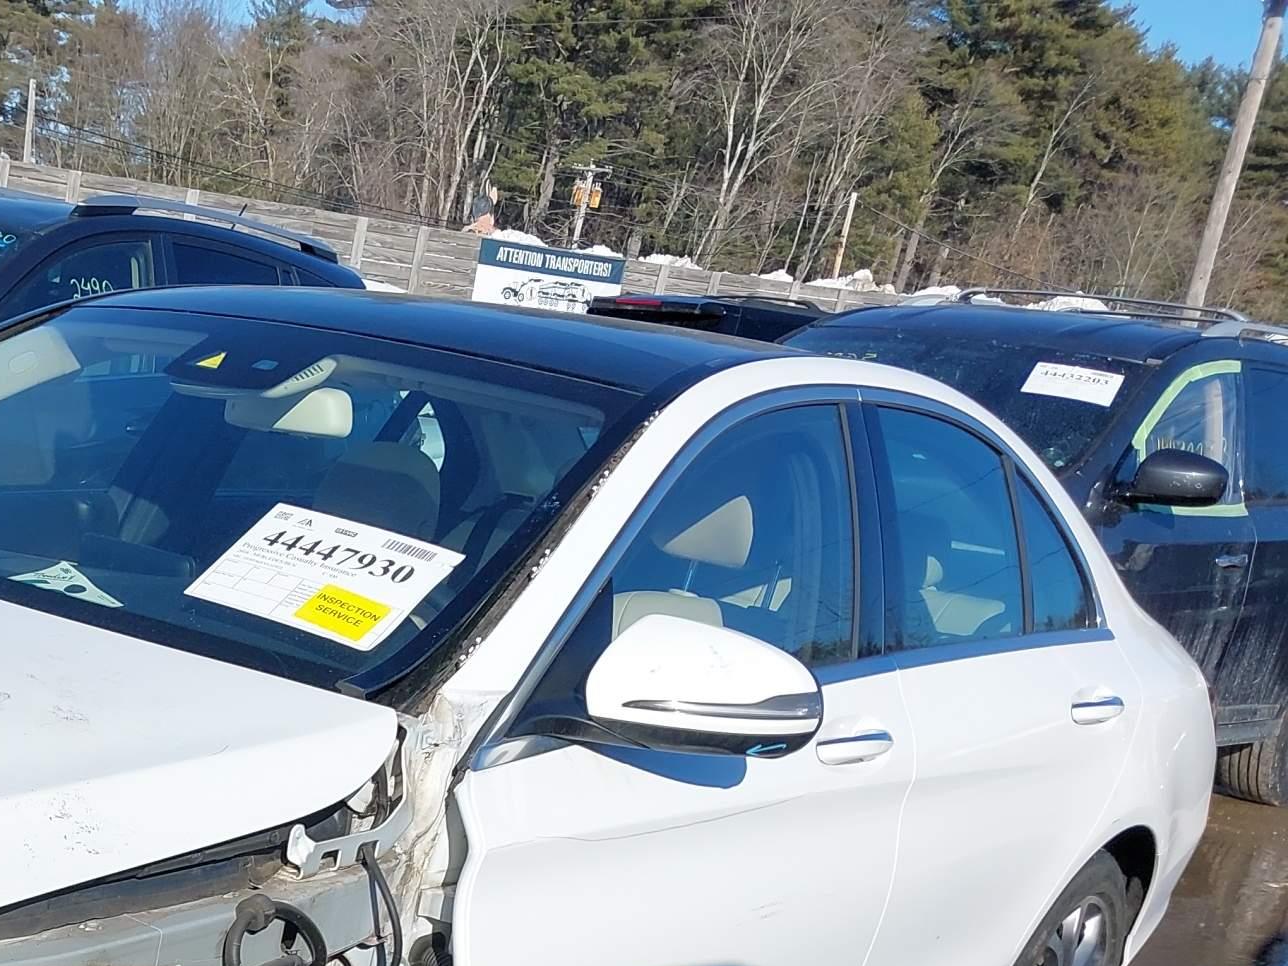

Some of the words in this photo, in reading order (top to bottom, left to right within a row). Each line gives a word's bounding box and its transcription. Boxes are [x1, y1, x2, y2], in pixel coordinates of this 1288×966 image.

[496, 246, 544, 268] ATTENTION
[544, 254, 613, 278] TRANSPORTERS!
[263, 529, 415, 584] 44447930
[315, 604, 364, 628] SERVICE
[316, 592, 381, 622] INSPECTION
